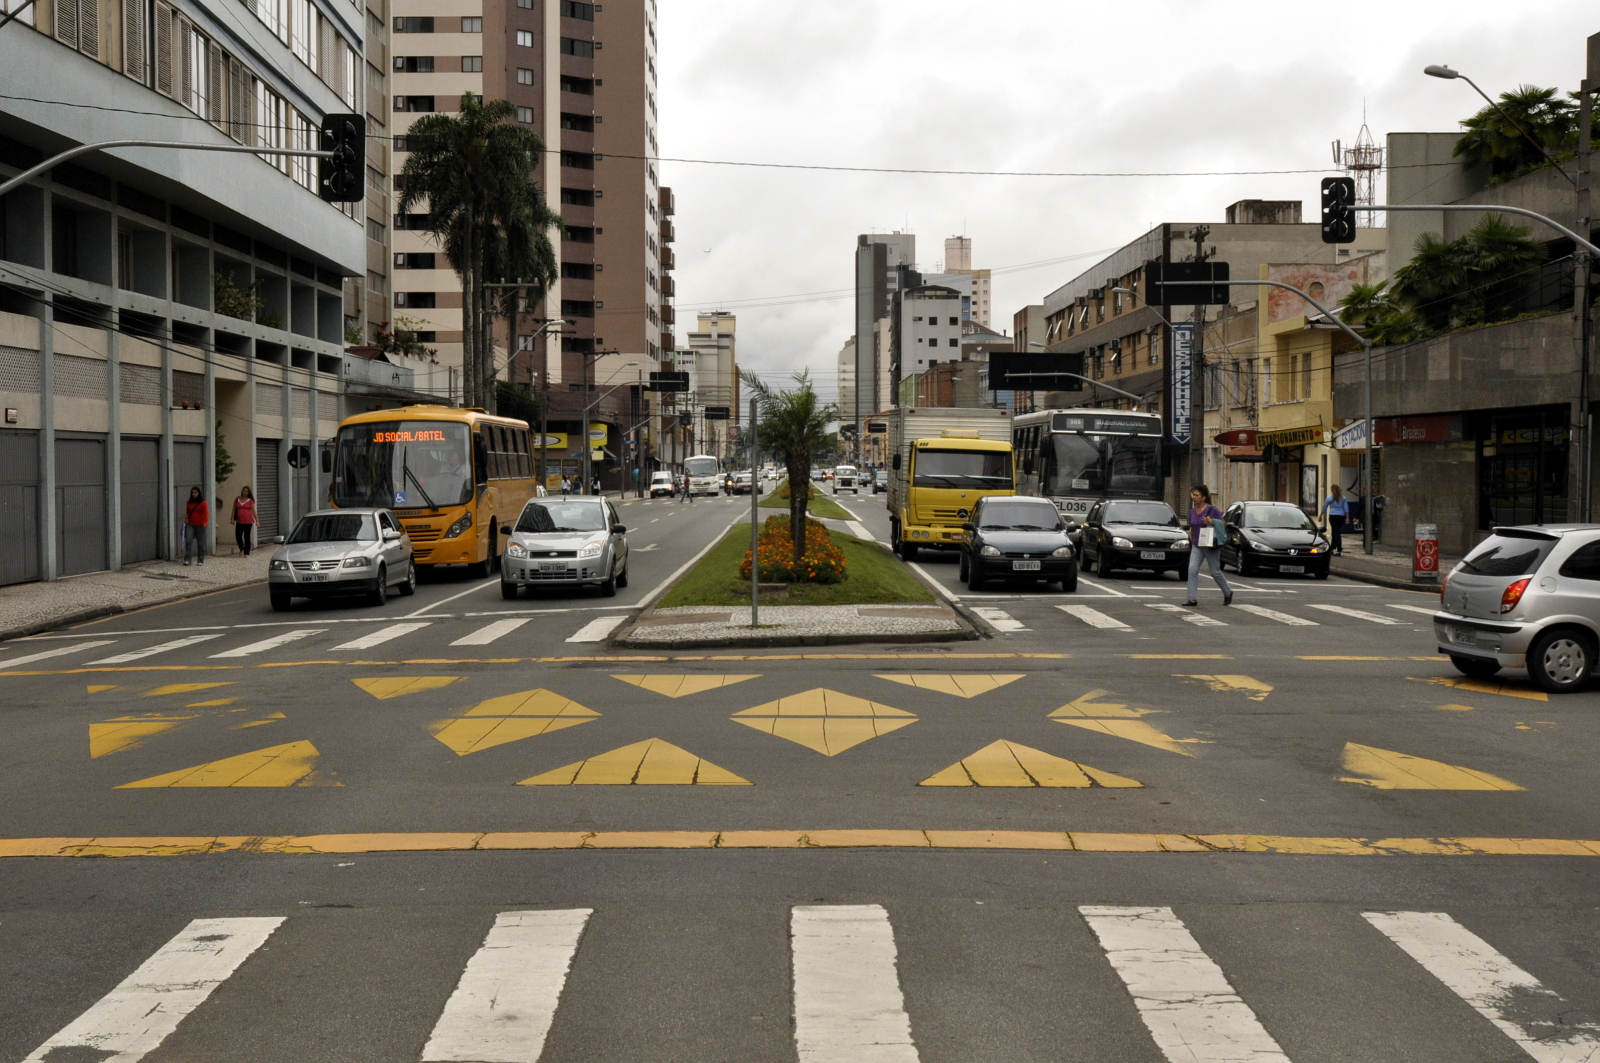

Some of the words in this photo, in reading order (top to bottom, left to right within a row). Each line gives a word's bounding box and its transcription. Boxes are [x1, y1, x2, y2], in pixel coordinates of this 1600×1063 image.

[1175, 330, 1191, 433] DESPACHANTE
[1258, 429, 1314, 448] ESTACIONAMENTO
[1402, 426, 1426, 440] Bradesco
